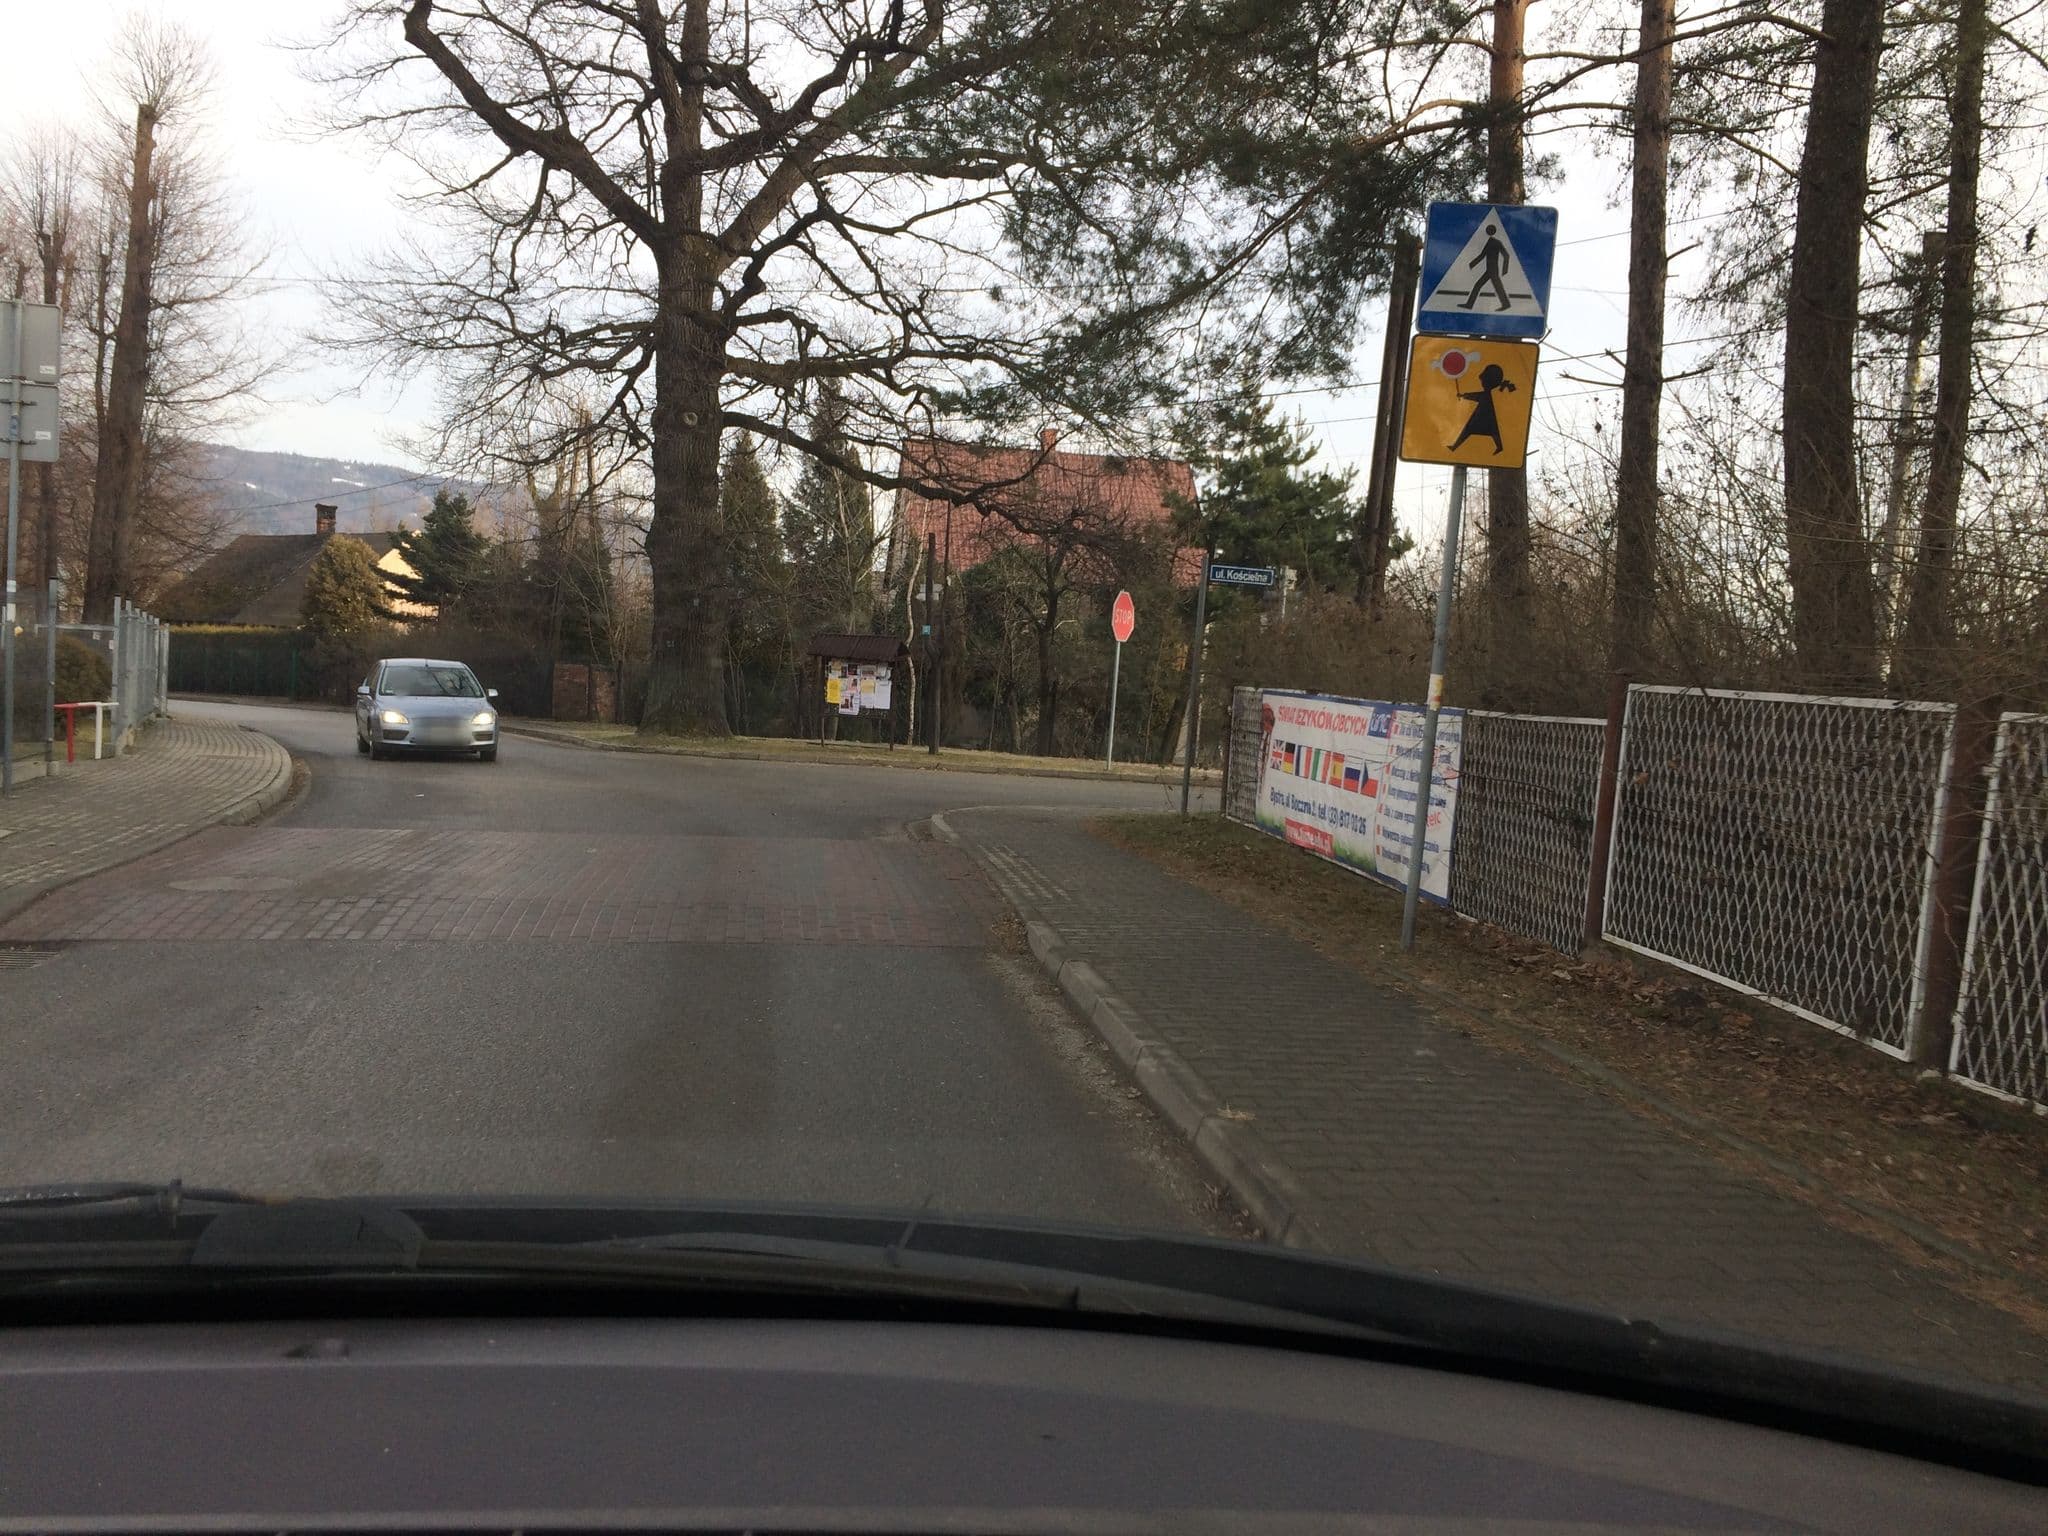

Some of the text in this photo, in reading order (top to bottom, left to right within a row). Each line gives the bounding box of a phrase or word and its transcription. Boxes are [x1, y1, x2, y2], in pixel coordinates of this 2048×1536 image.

[1215, 569, 1268, 583] ul. Kościelna
[1114, 608, 1133, 625] STOP
